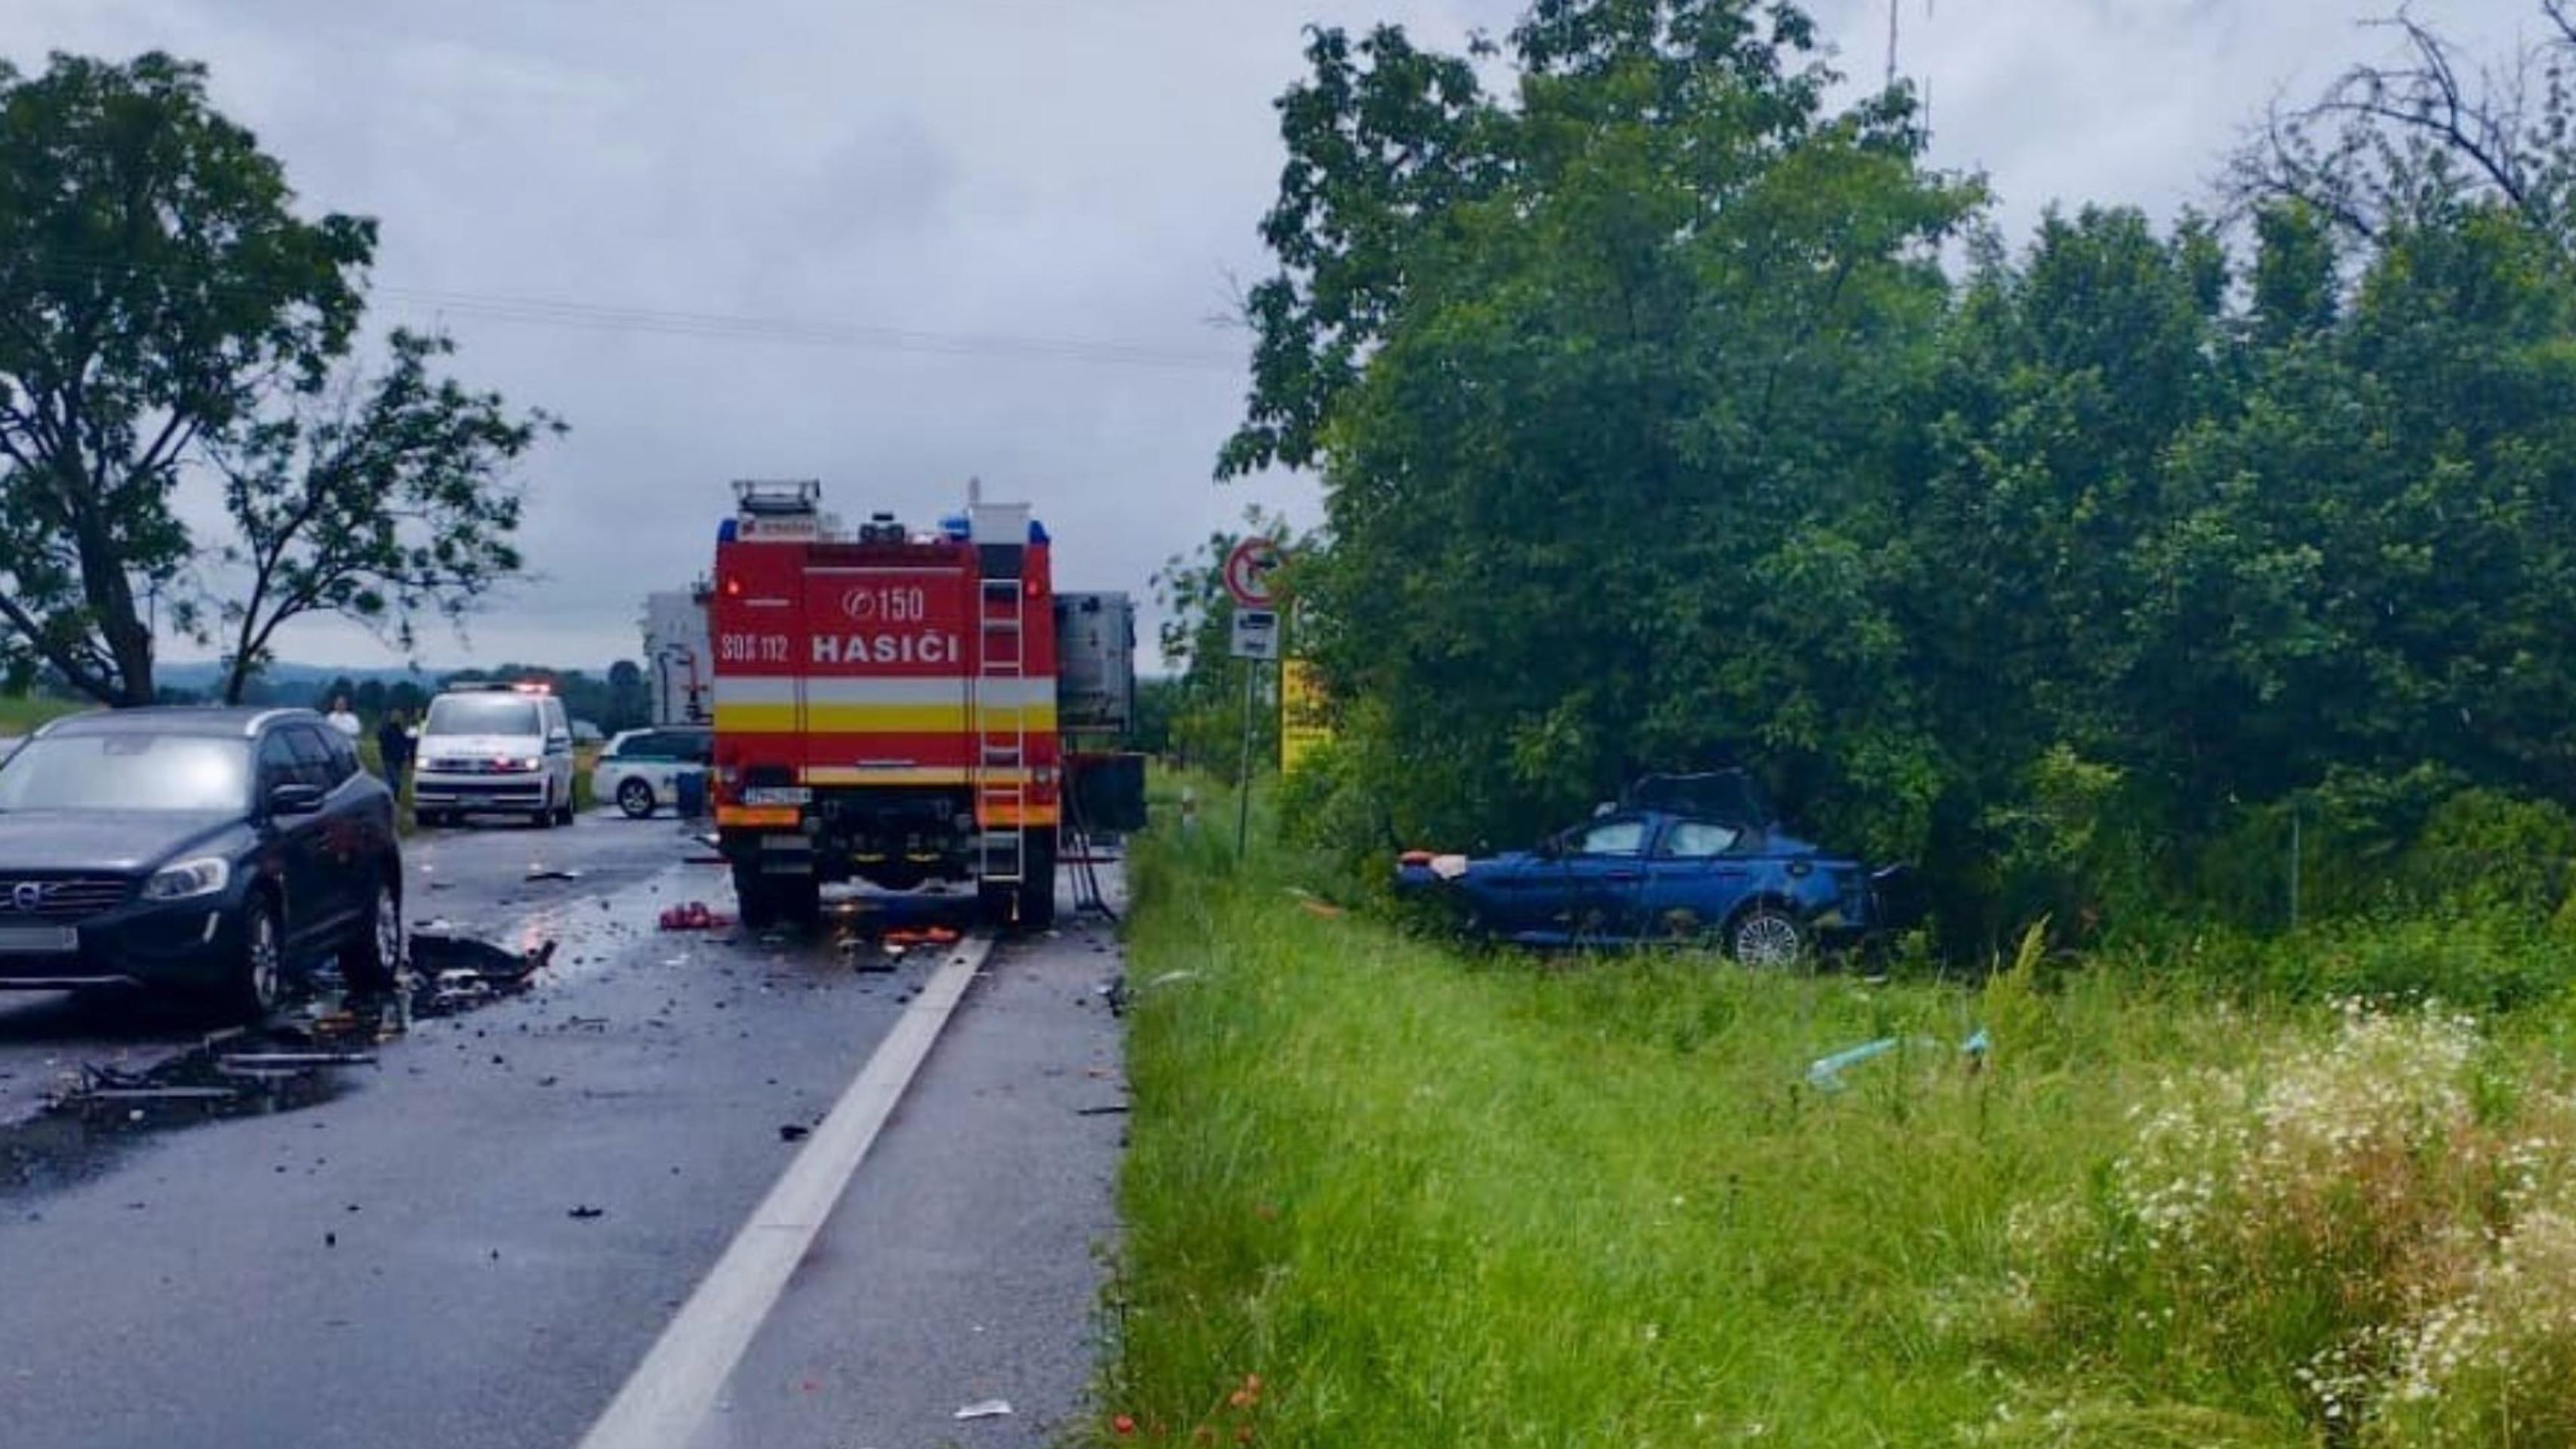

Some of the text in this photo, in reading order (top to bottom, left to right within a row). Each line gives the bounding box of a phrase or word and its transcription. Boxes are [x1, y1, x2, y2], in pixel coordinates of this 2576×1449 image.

[879, 588, 924, 621] 150
[761, 634, 788, 662] 112
[811, 628, 959, 663] HASIČI
